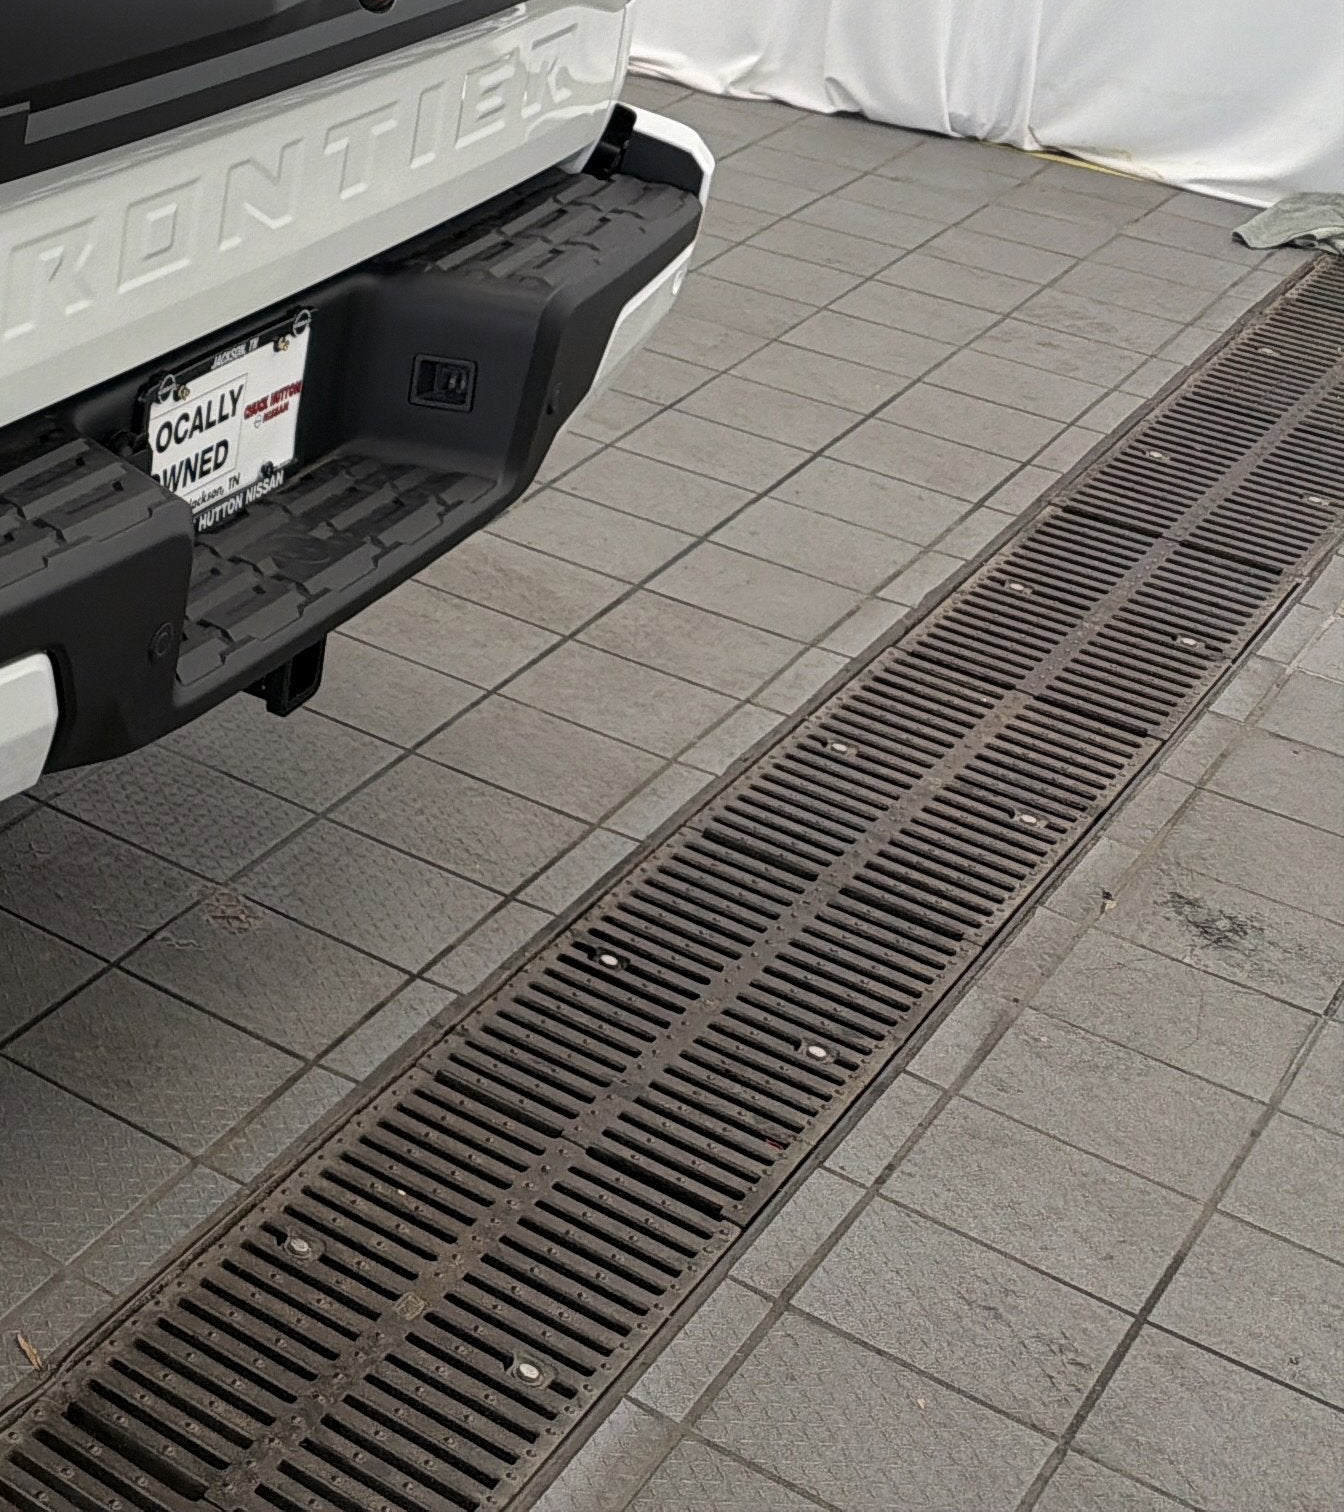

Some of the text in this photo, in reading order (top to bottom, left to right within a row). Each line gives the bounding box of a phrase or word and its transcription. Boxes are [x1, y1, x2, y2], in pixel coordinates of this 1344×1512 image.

[156, 384, 244, 454] OCALLY
[198, 469, 284, 532] HUTTON NISSAN
[229, 472, 241, 490] TN
